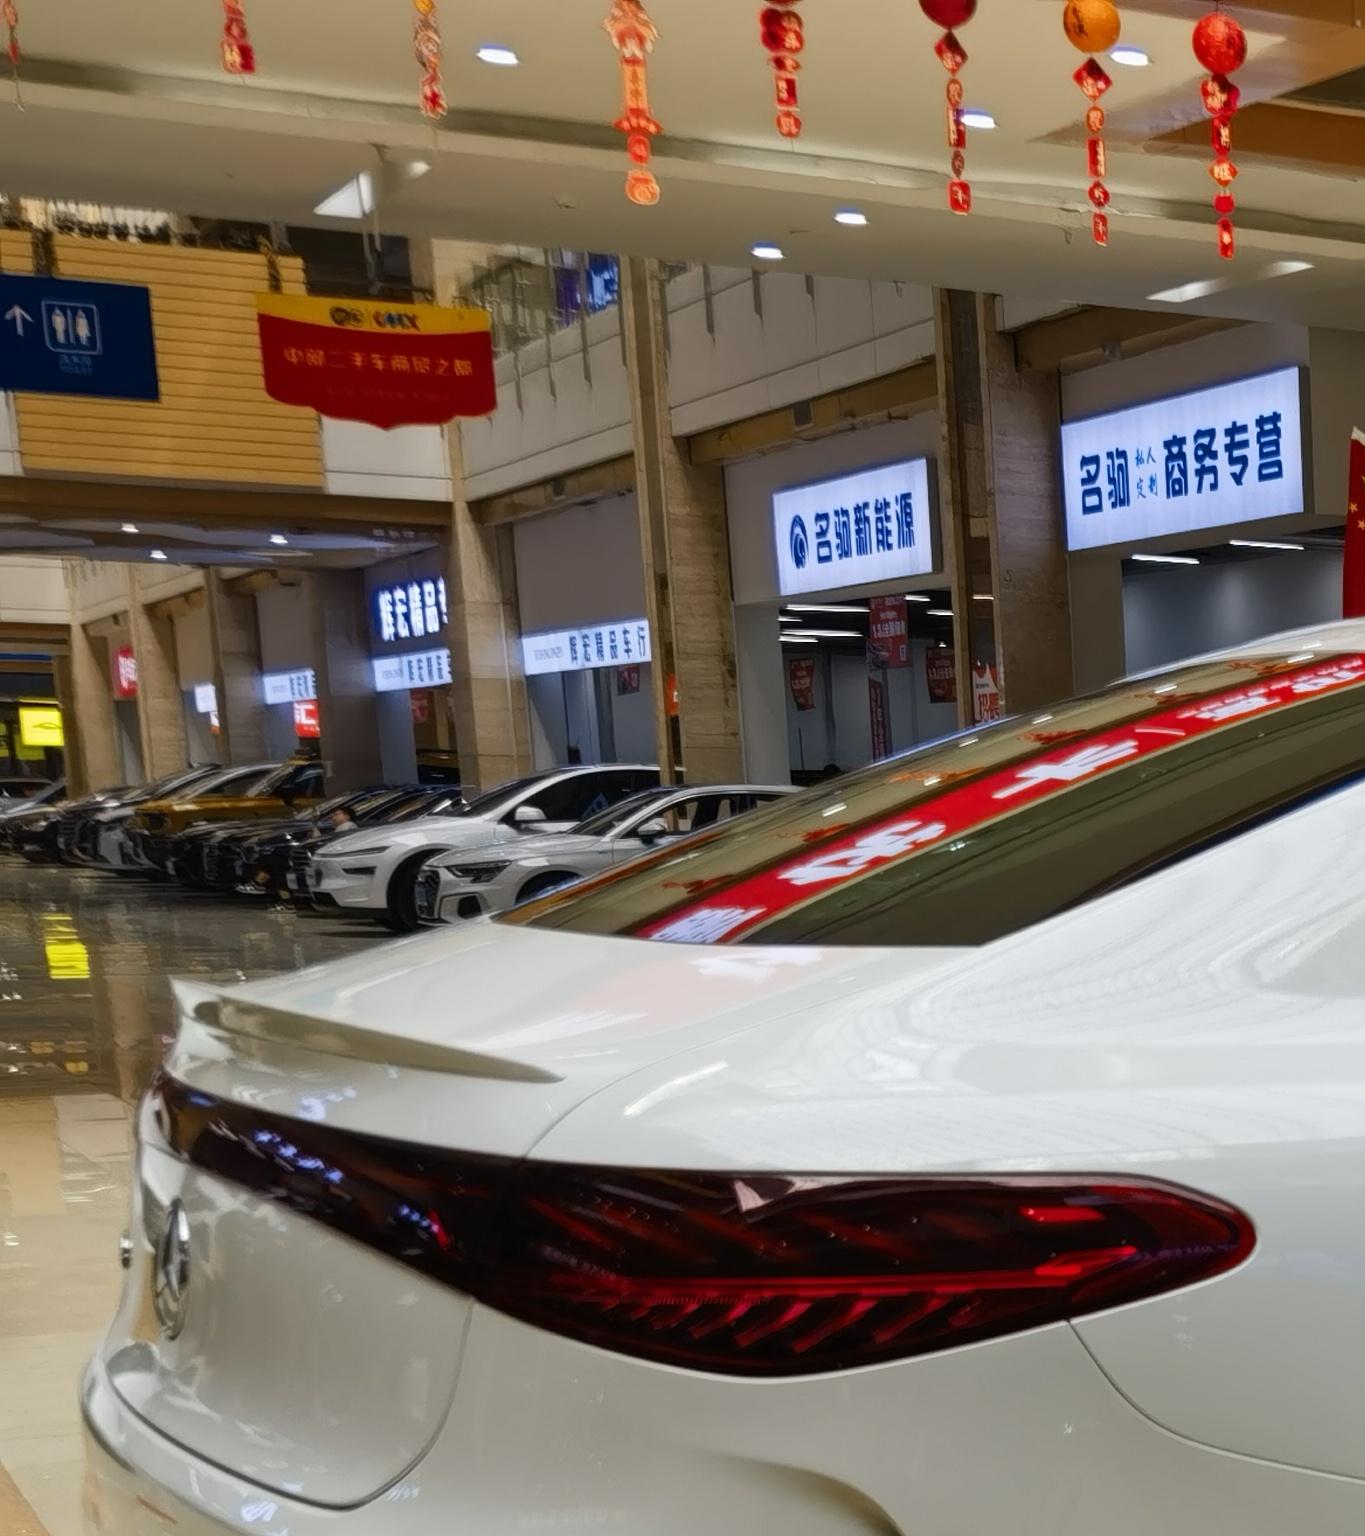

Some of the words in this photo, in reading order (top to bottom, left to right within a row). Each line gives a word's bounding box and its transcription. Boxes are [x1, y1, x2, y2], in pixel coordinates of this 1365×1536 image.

[814, 492, 916, 565] 名驹新能源
